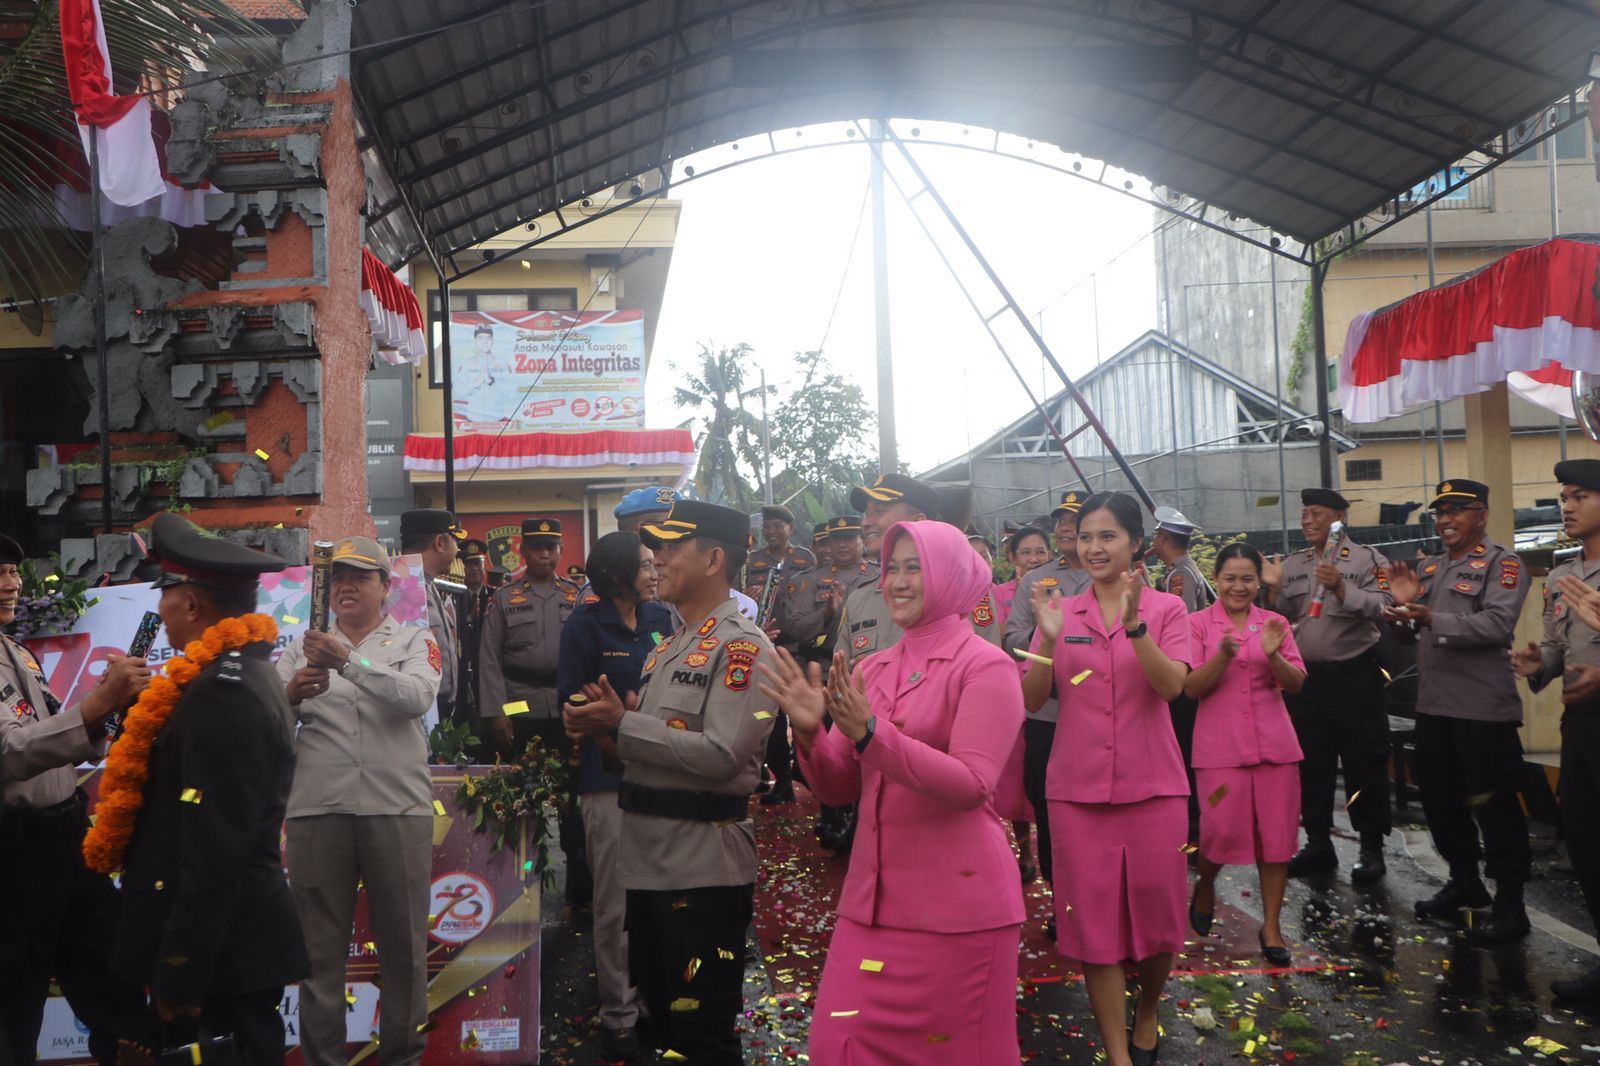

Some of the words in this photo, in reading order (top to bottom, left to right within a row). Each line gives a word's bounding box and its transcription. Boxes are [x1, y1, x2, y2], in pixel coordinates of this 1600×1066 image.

[514, 344, 538, 352] Anda
[588, 342, 628, 351] Kawasan
[514, 354, 557, 373] Zona
[561, 352, 641, 377] Integritas
[1340, 573, 1359, 581] OLRI
[671, 670, 708, 687] POLRI
[52, 1037, 74, 1048] JASA
